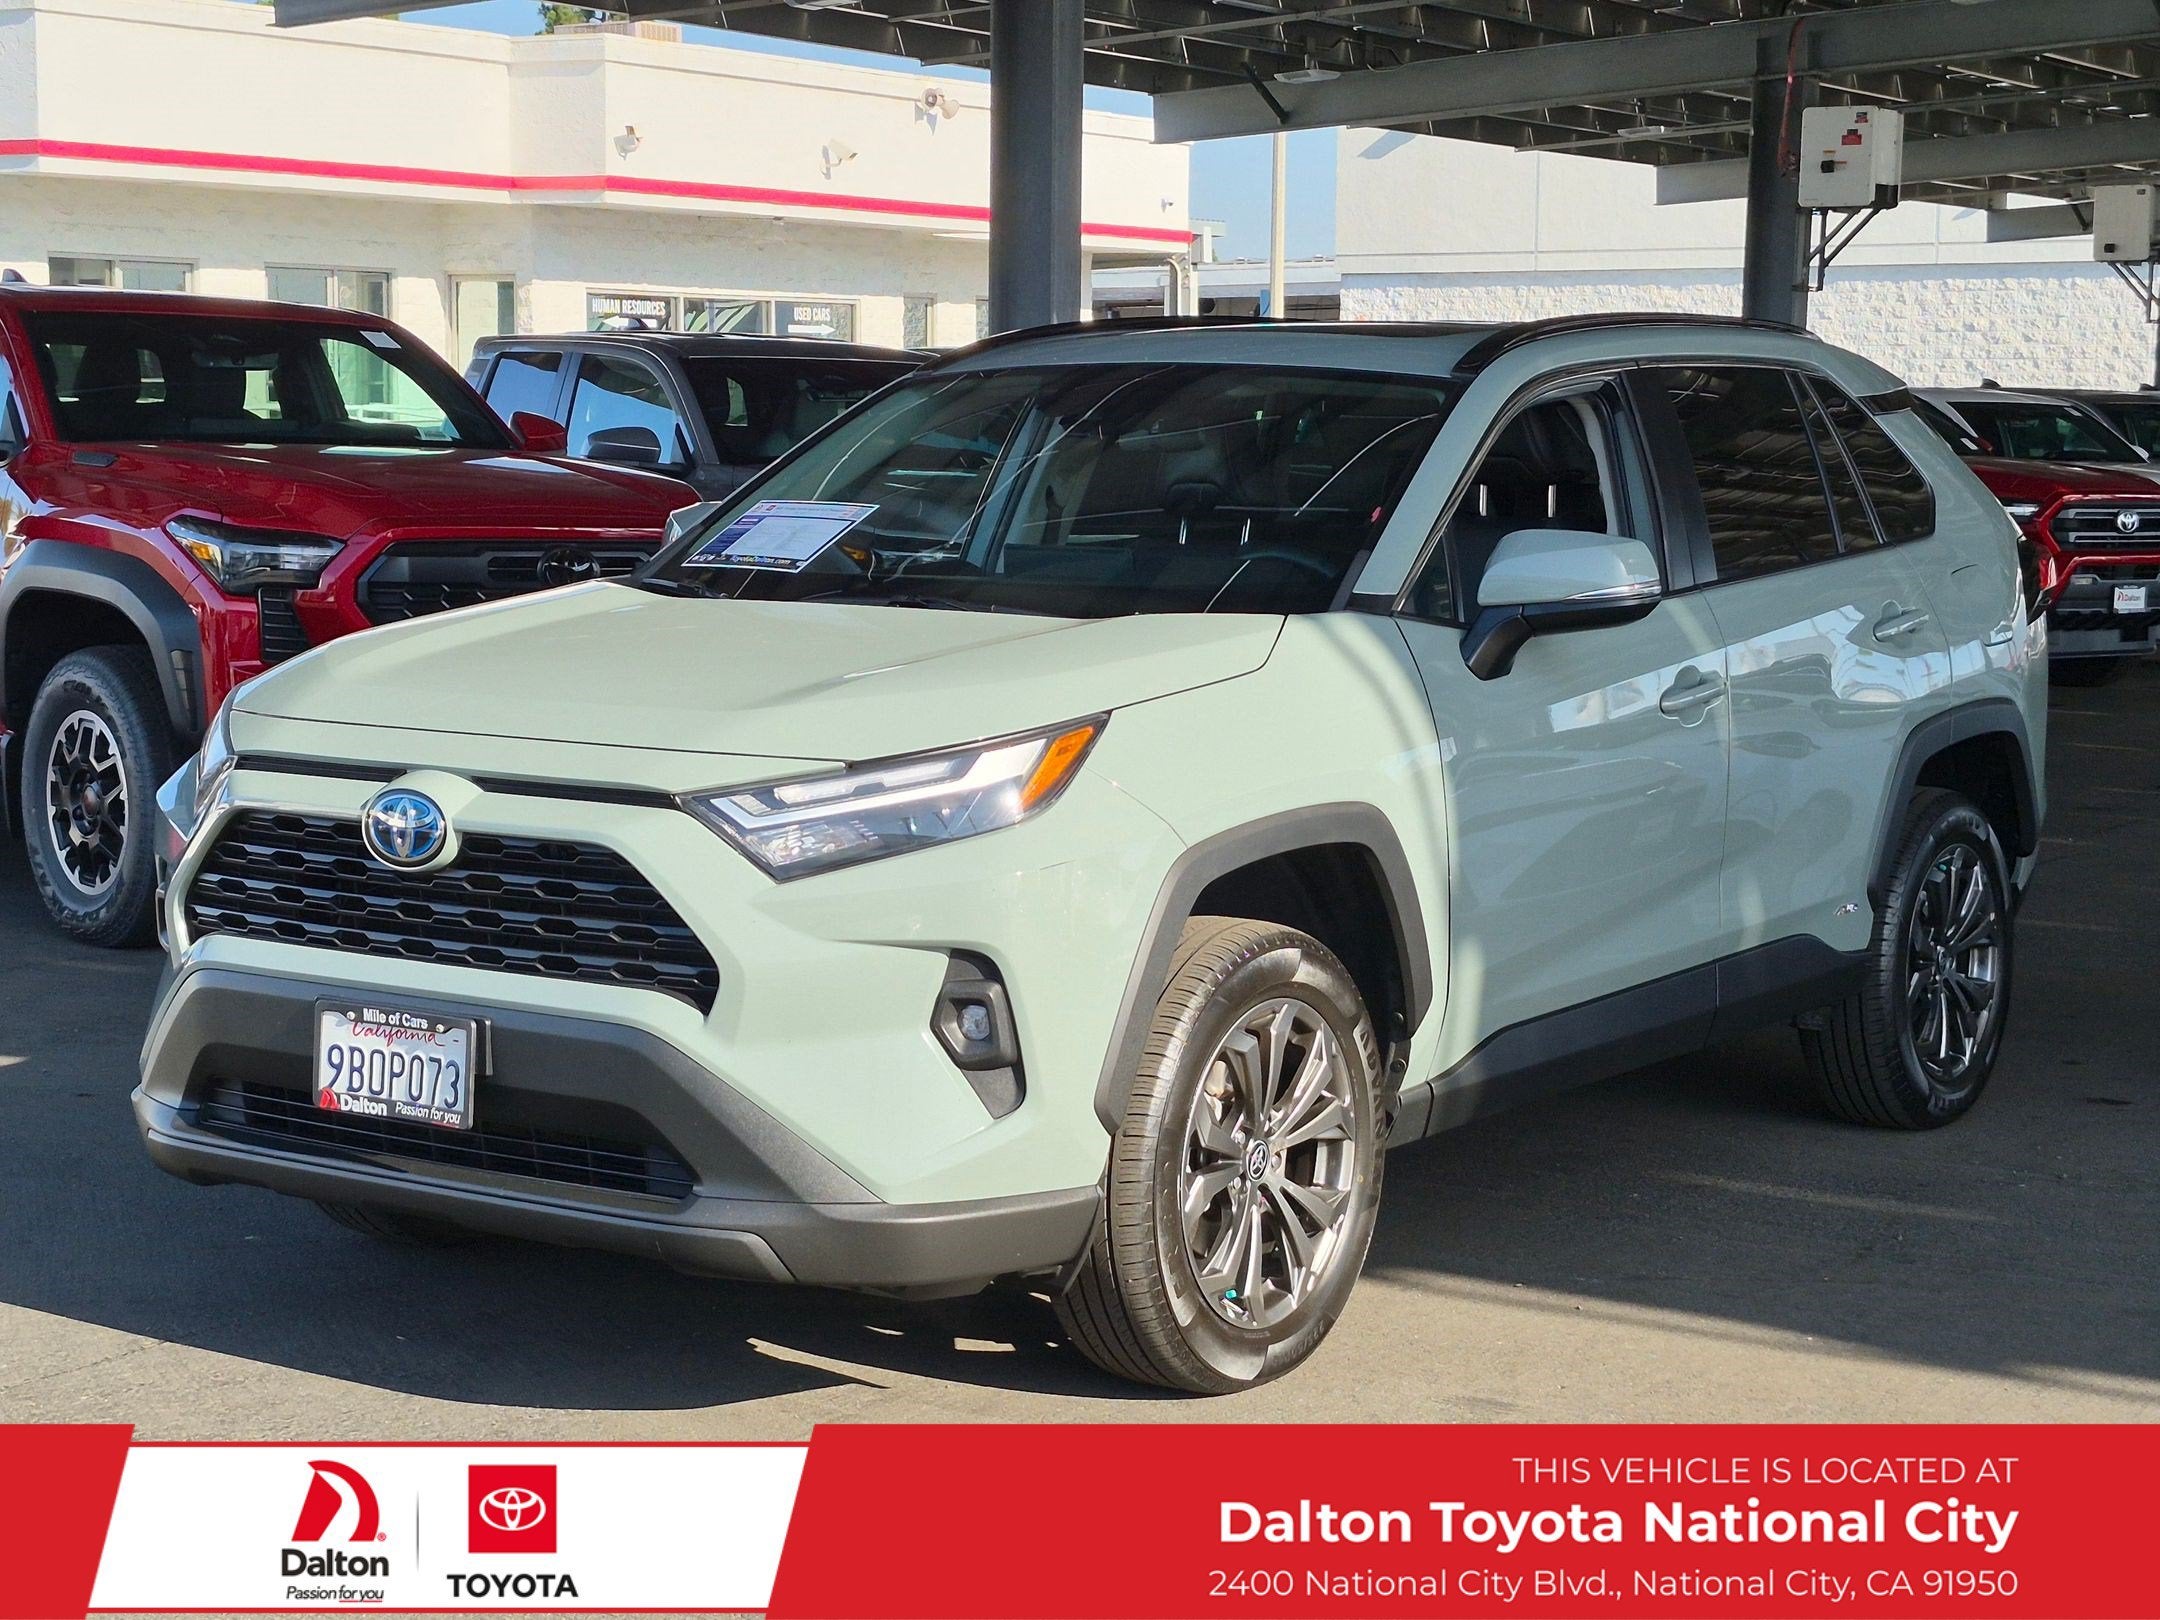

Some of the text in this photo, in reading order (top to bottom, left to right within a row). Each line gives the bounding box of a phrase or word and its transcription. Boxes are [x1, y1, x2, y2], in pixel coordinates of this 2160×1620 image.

[592, 298, 666, 316] HUMAN RESOURCES
[793, 307, 831, 322] USED CARS
[363, 1008, 429, 1030] Mile of Cars
[351, 1021, 446, 1047] California
[340, 1094, 461, 1125] Dalton Passion for you
